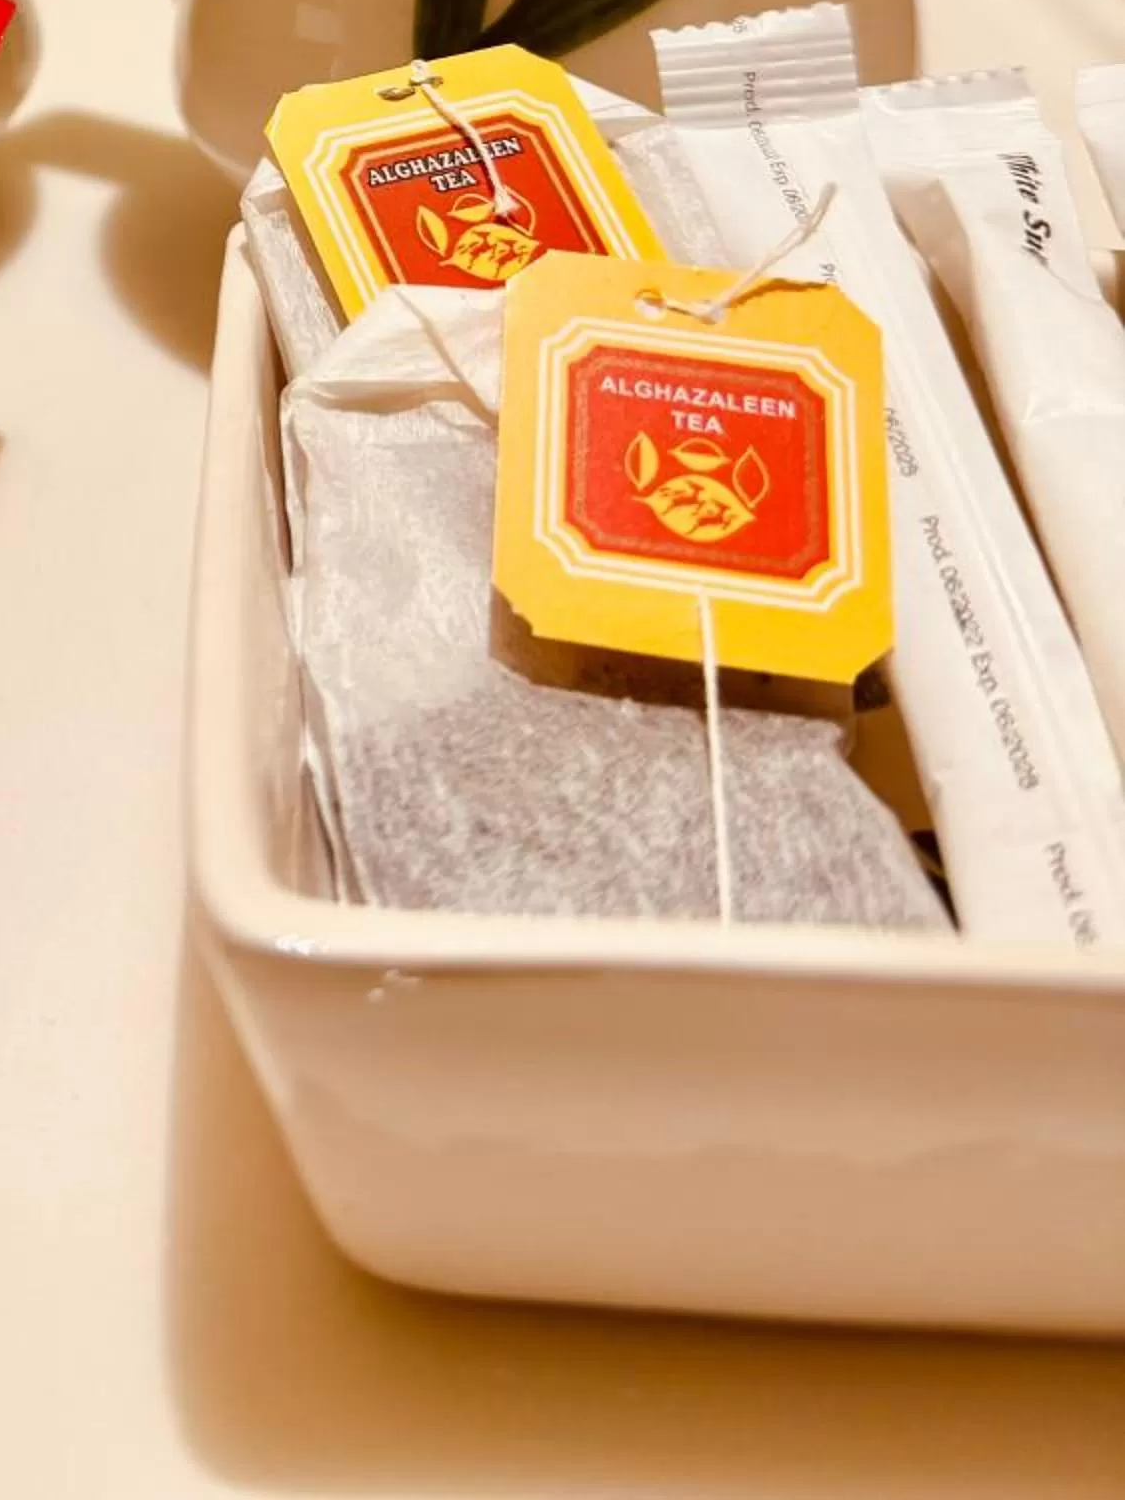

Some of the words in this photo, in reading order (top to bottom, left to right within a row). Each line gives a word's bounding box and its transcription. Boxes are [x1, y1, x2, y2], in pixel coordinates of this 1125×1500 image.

[430, 170, 478, 194] TEA
[599, 375, 798, 420] ALGHAZALEEN
[670, 410, 726, 436] TEA
